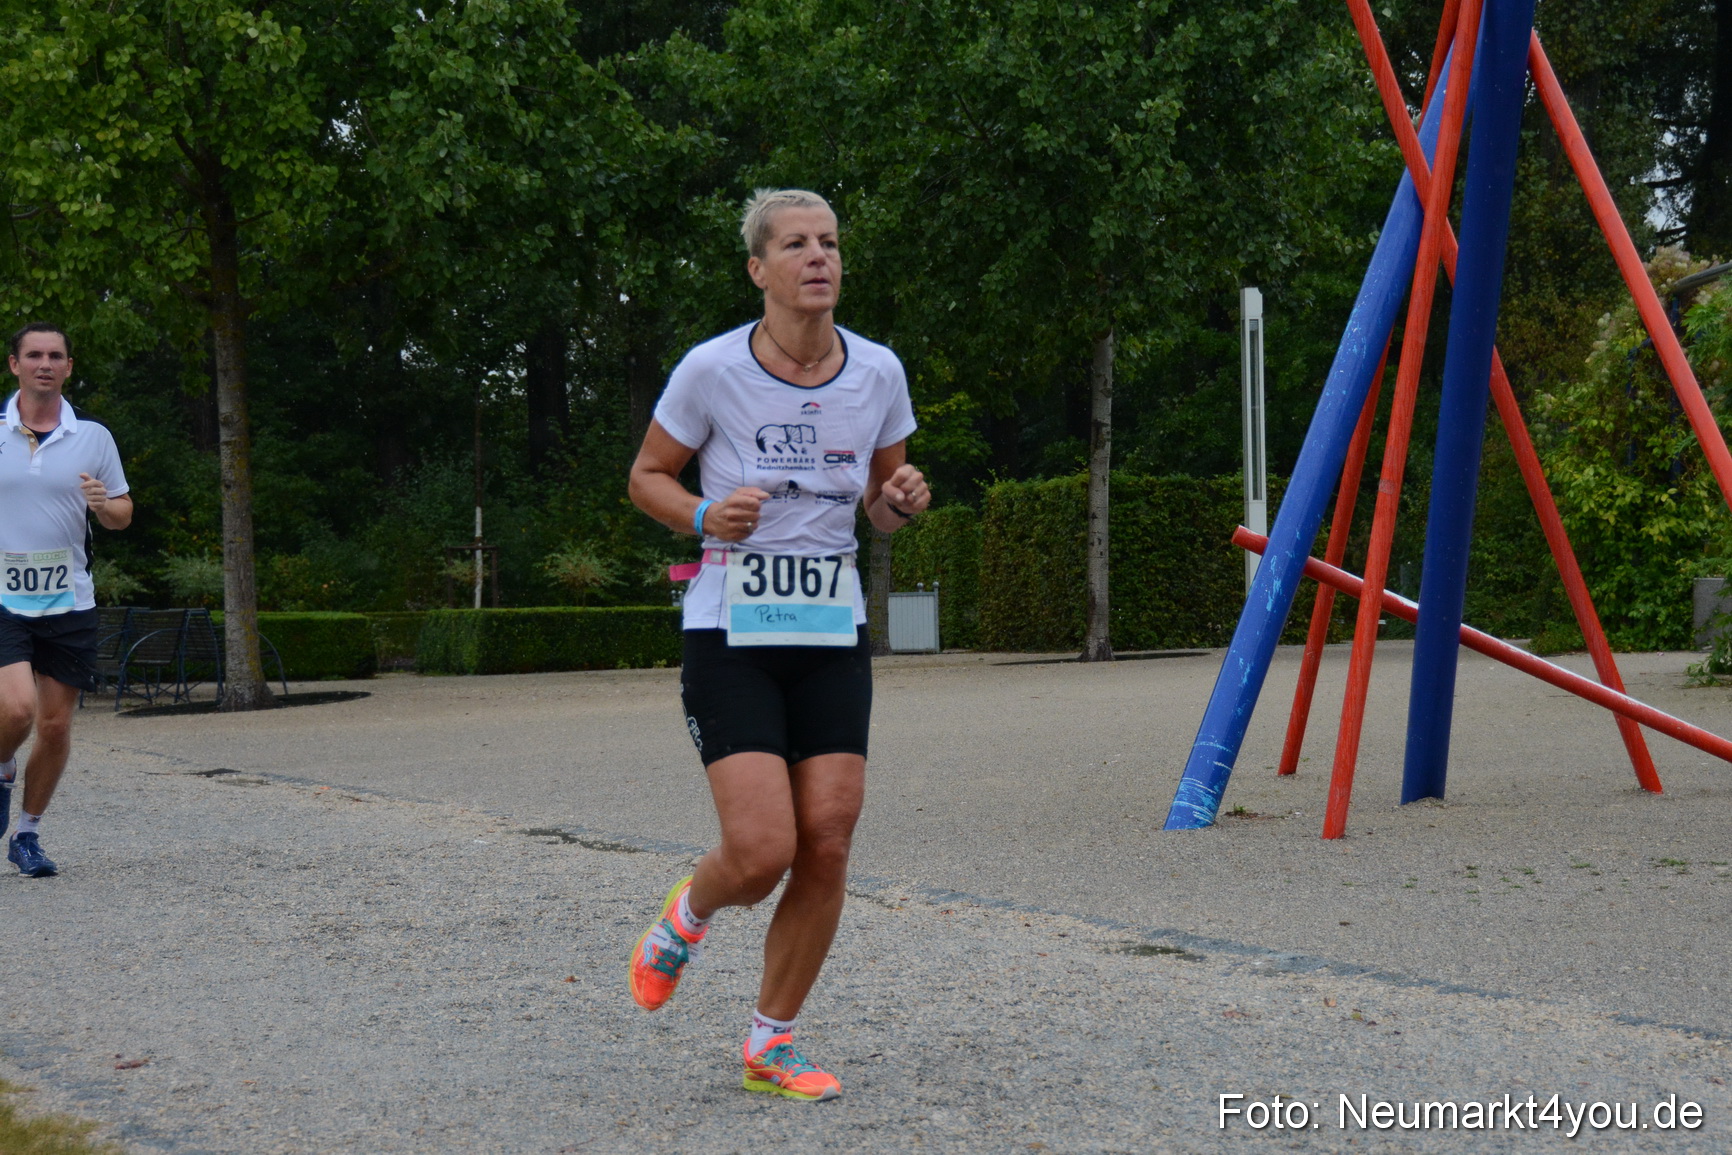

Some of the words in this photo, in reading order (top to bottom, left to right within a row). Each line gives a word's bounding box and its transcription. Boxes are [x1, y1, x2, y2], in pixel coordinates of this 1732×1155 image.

[6, 565, 69, 592] 3072
[742, 553, 843, 598] 3067
[754, 604, 798, 623] Petra
